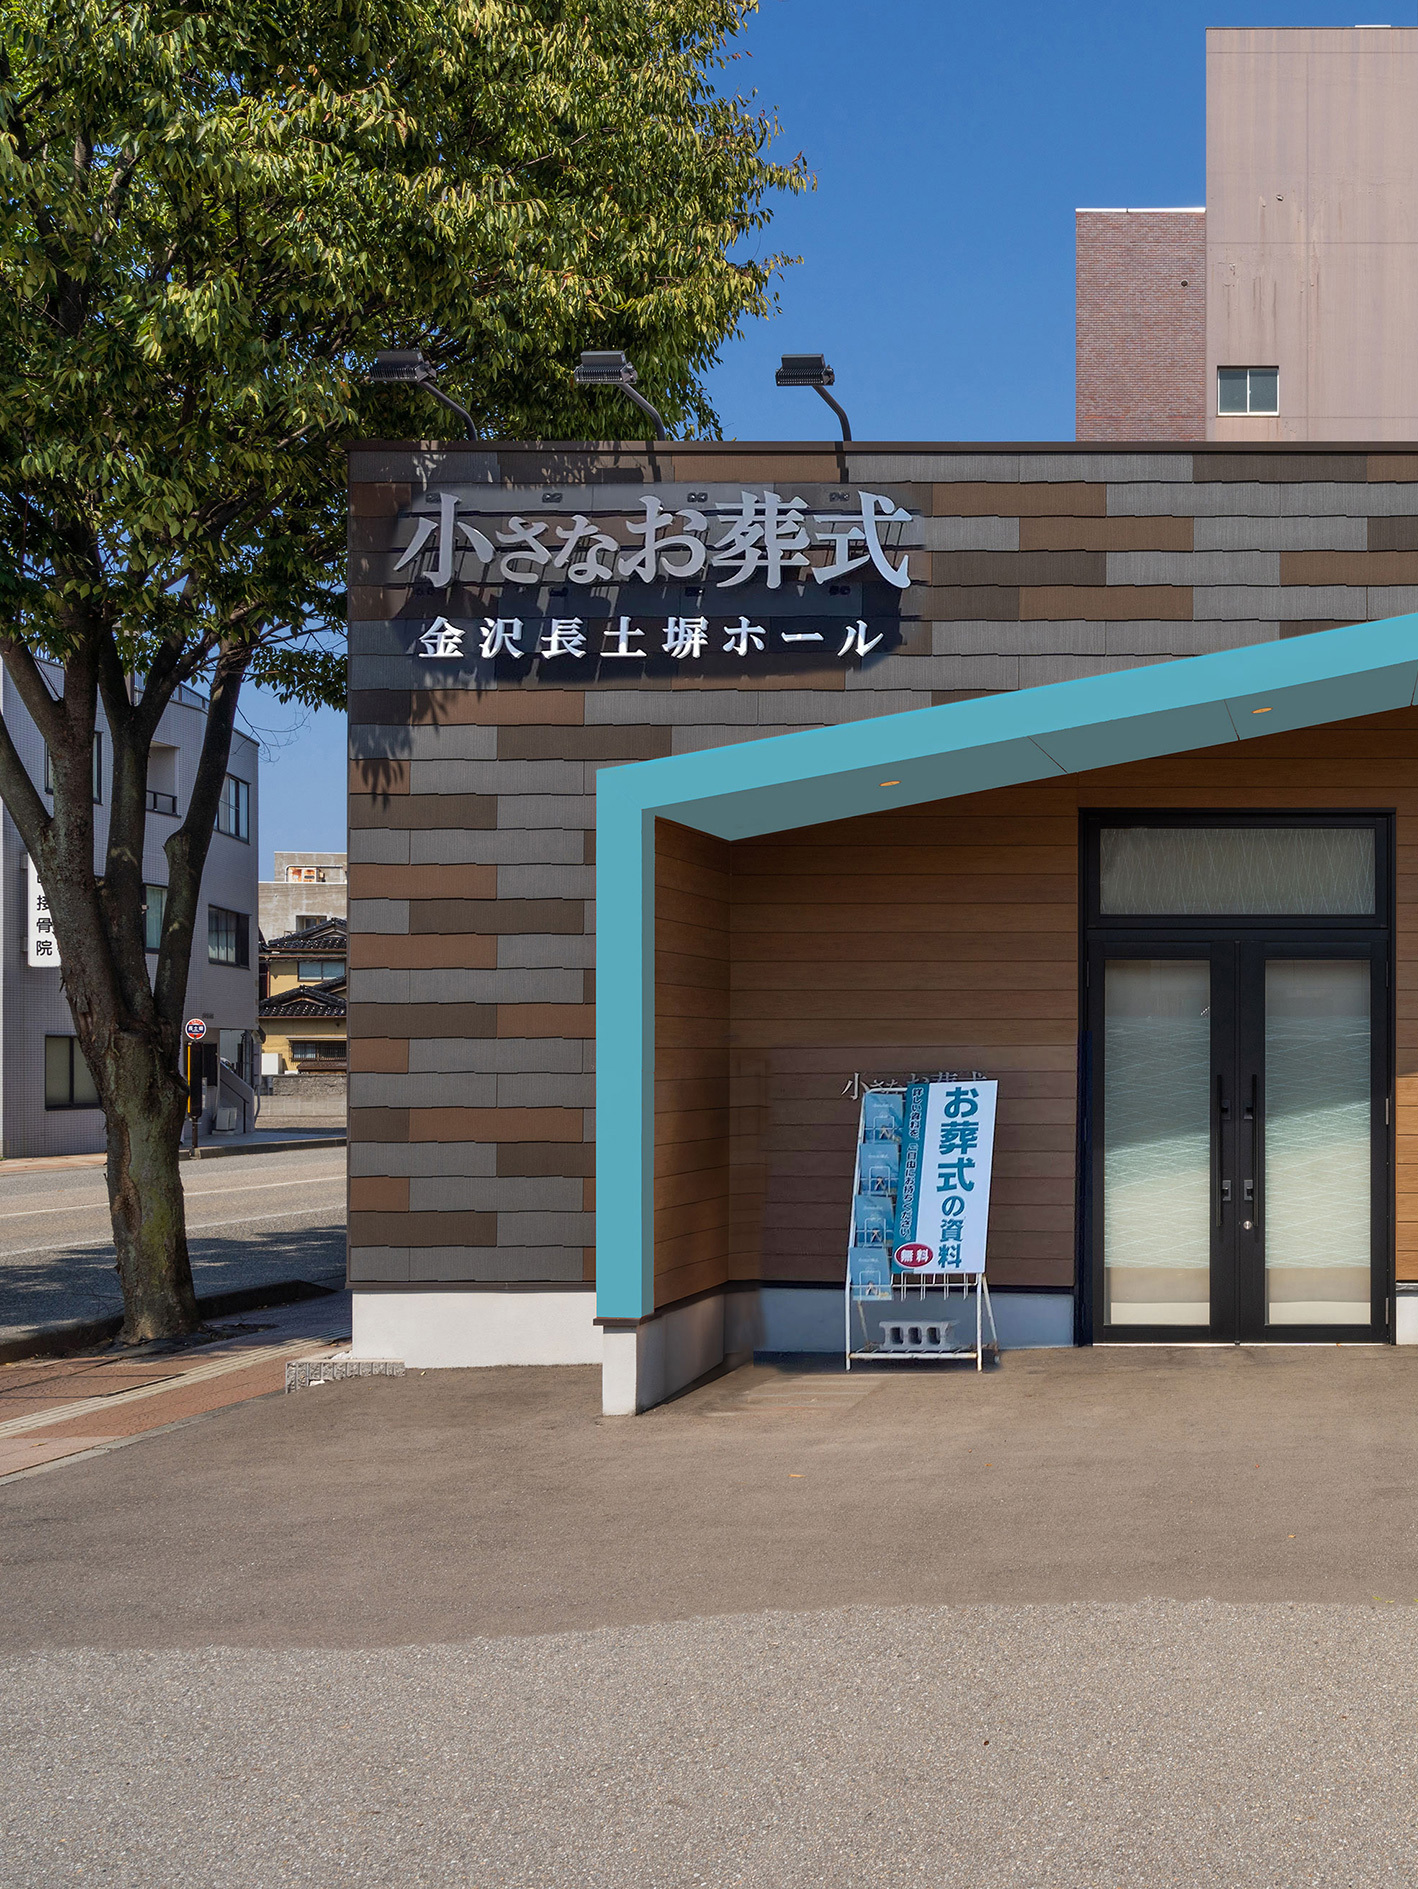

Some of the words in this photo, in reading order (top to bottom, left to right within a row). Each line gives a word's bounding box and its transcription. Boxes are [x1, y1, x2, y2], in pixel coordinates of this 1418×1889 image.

[394, 490, 912, 589] 小さなお葬式
[418, 616, 884, 659] 金沢長土塀ホール
[937, 1087, 980, 1268] お葬式の資料
[901, 1249, 929, 1263] 無料
